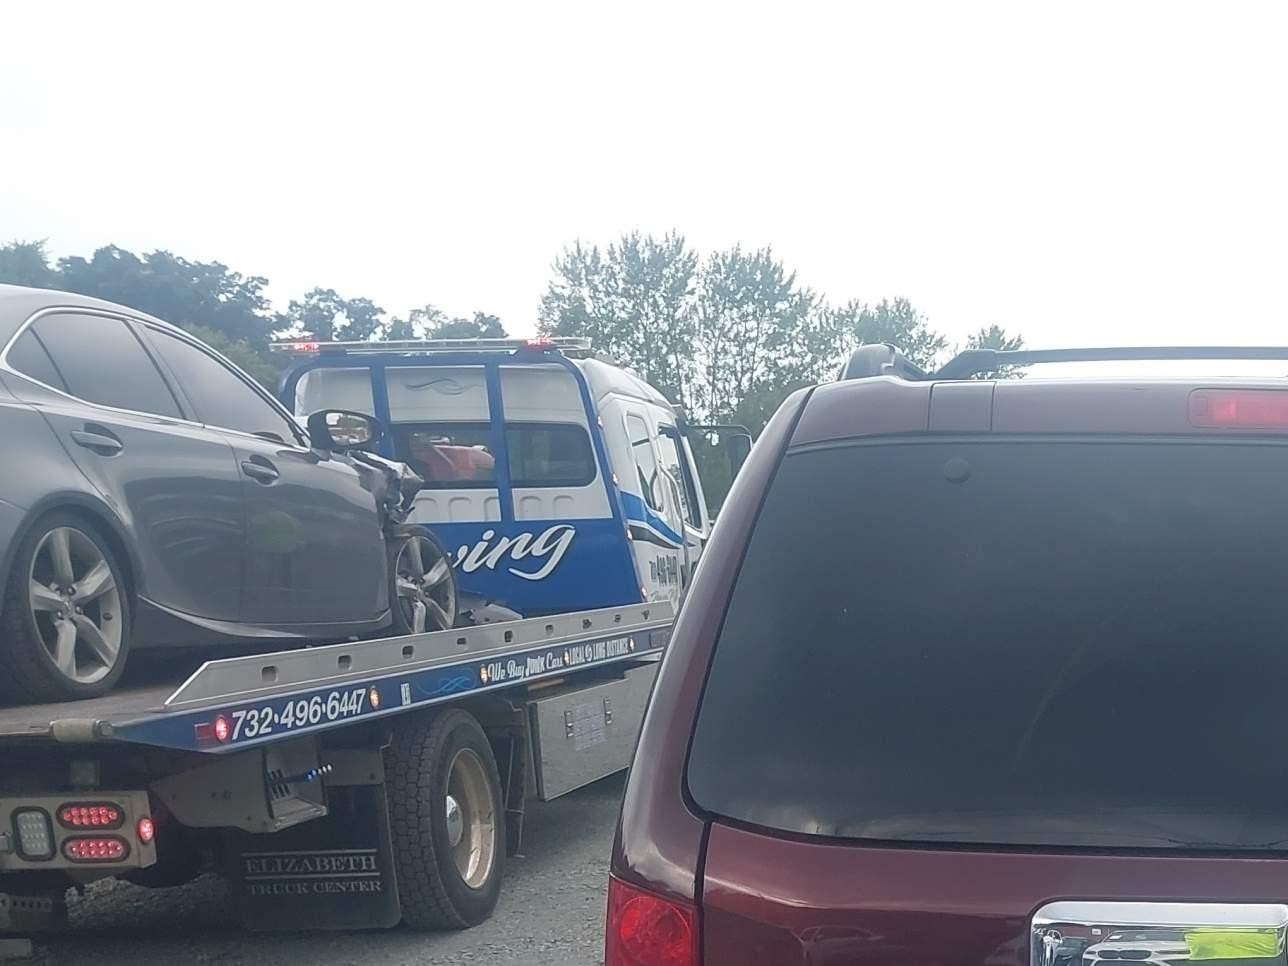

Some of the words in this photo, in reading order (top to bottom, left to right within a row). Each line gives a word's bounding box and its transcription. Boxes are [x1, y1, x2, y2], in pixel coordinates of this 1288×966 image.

[246, 855, 377, 873] ELIZABETH
[251, 882, 308, 896] TRUCK
[313, 880, 382, 894] CENTER
